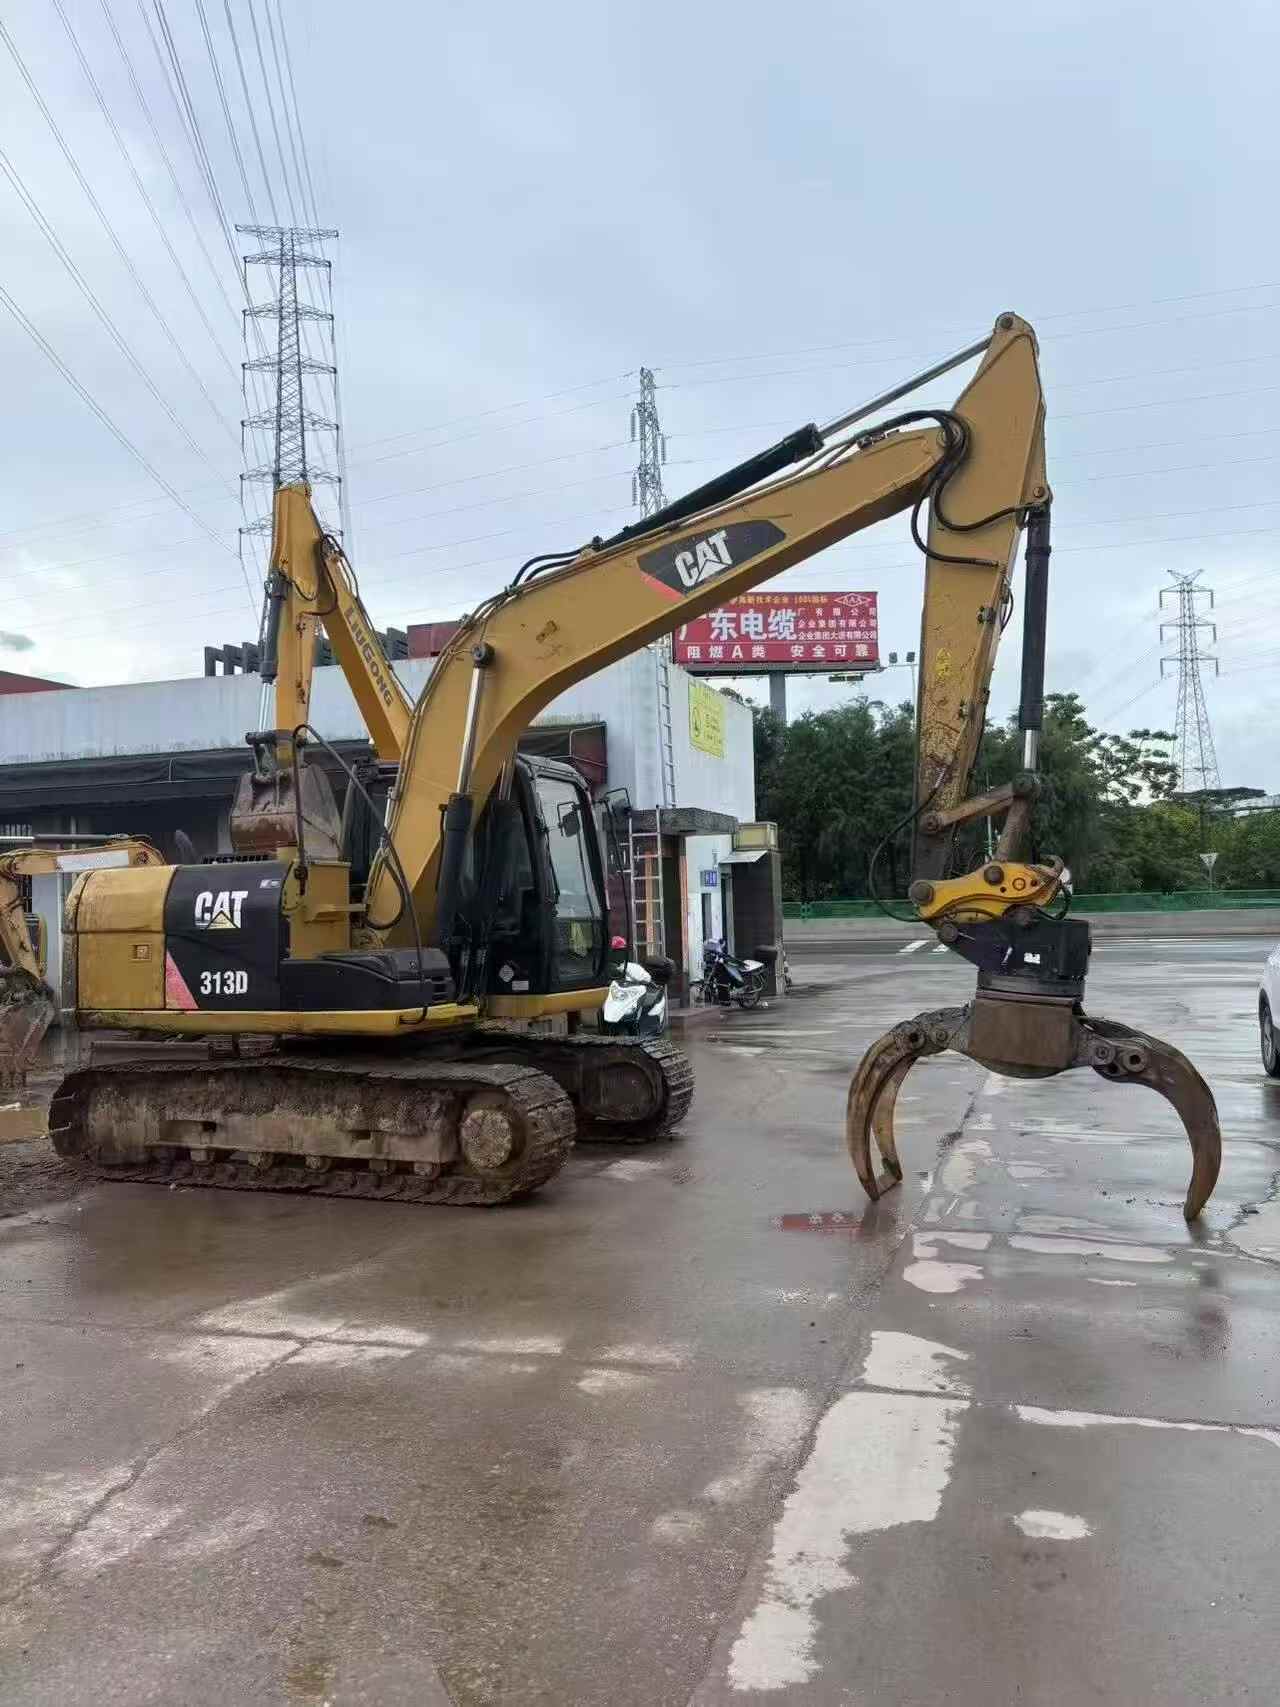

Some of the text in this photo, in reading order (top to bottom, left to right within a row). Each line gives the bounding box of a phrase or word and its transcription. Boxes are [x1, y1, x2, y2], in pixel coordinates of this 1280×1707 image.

[675, 530, 733, 587] CAT
[344, 607, 393, 706] LIUGONG
[790, 644, 869, 657] 安全可靠
[194, 890, 249, 929] CAT
[200, 970, 249, 995] 313D
